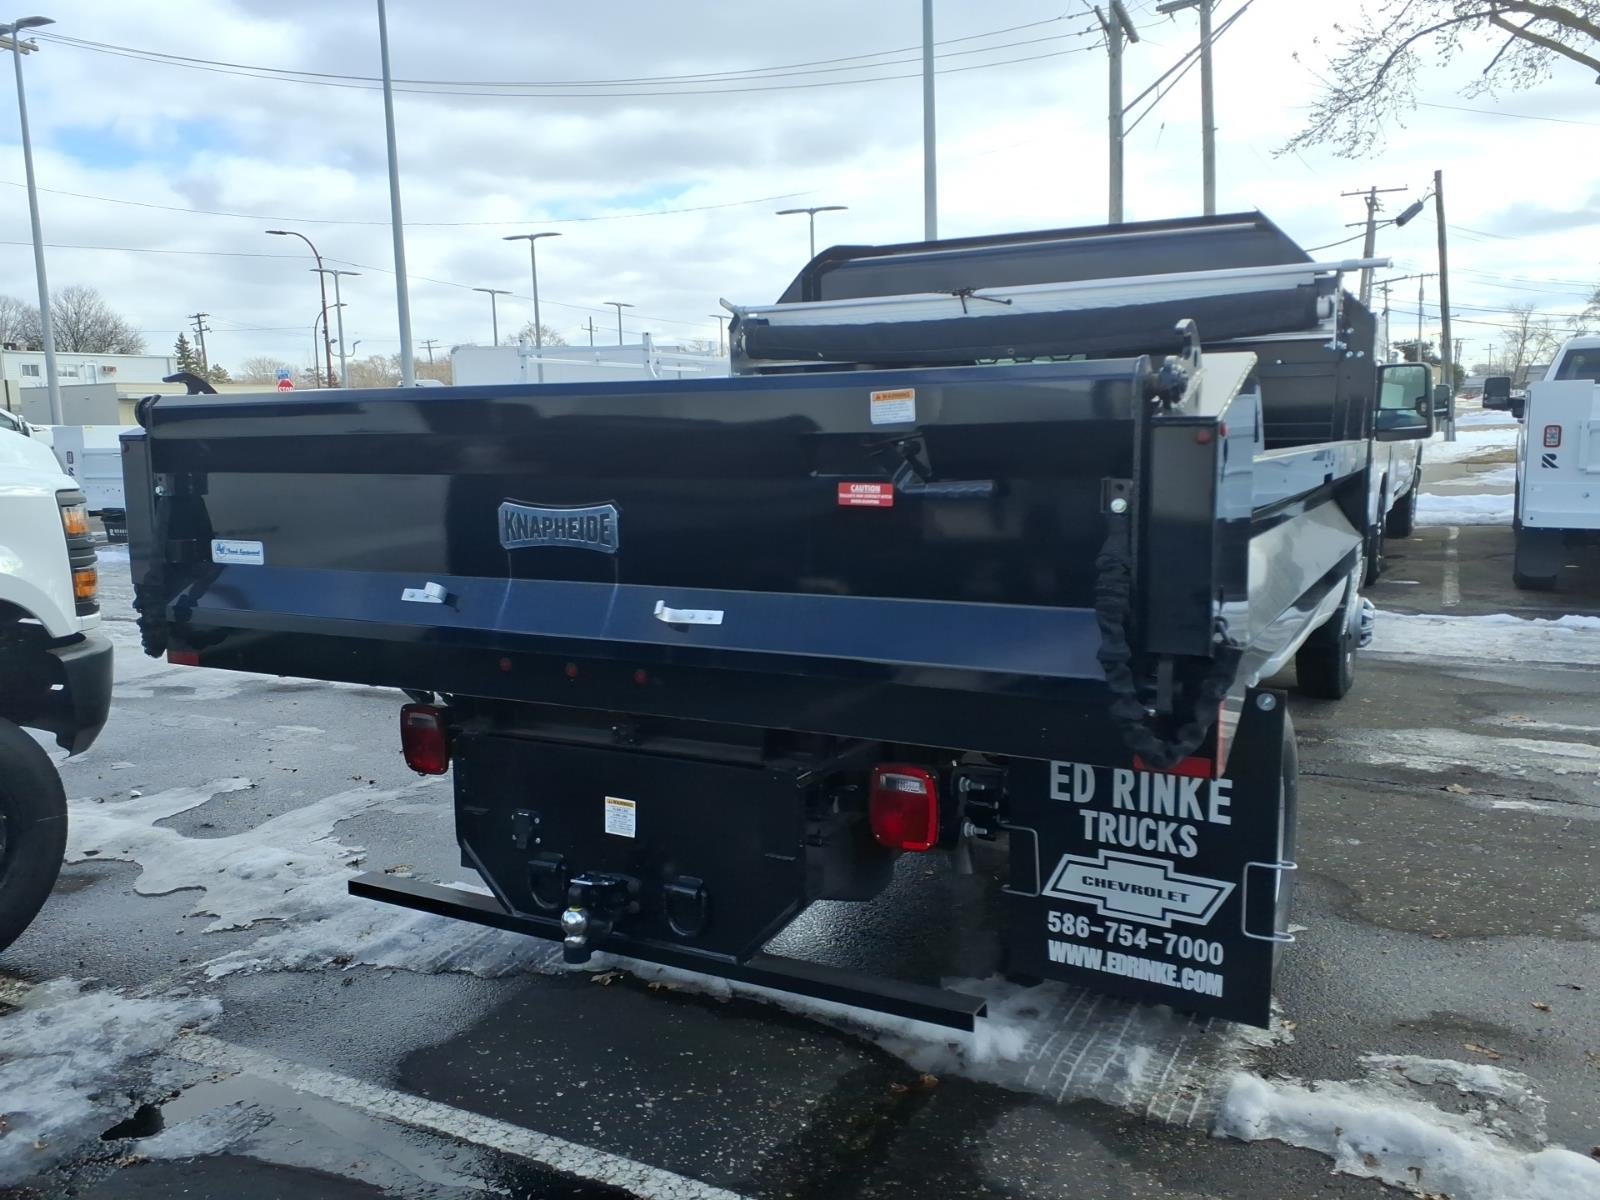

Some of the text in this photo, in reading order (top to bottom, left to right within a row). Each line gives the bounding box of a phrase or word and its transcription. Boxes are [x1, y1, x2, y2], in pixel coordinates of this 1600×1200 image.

[850, 484, 881, 494] CAUTION
[503, 510, 612, 547] KNAPHEIDE
[1050, 760, 1233, 826] ED RINKE
[1079, 808, 1199, 858] TRUCKS
[1081, 874, 1191, 904] CHEVROLET
[1047, 910, 1224, 966] 586-754-7000
[1047, 938, 1224, 998] WWW.EDRINKE.COM
